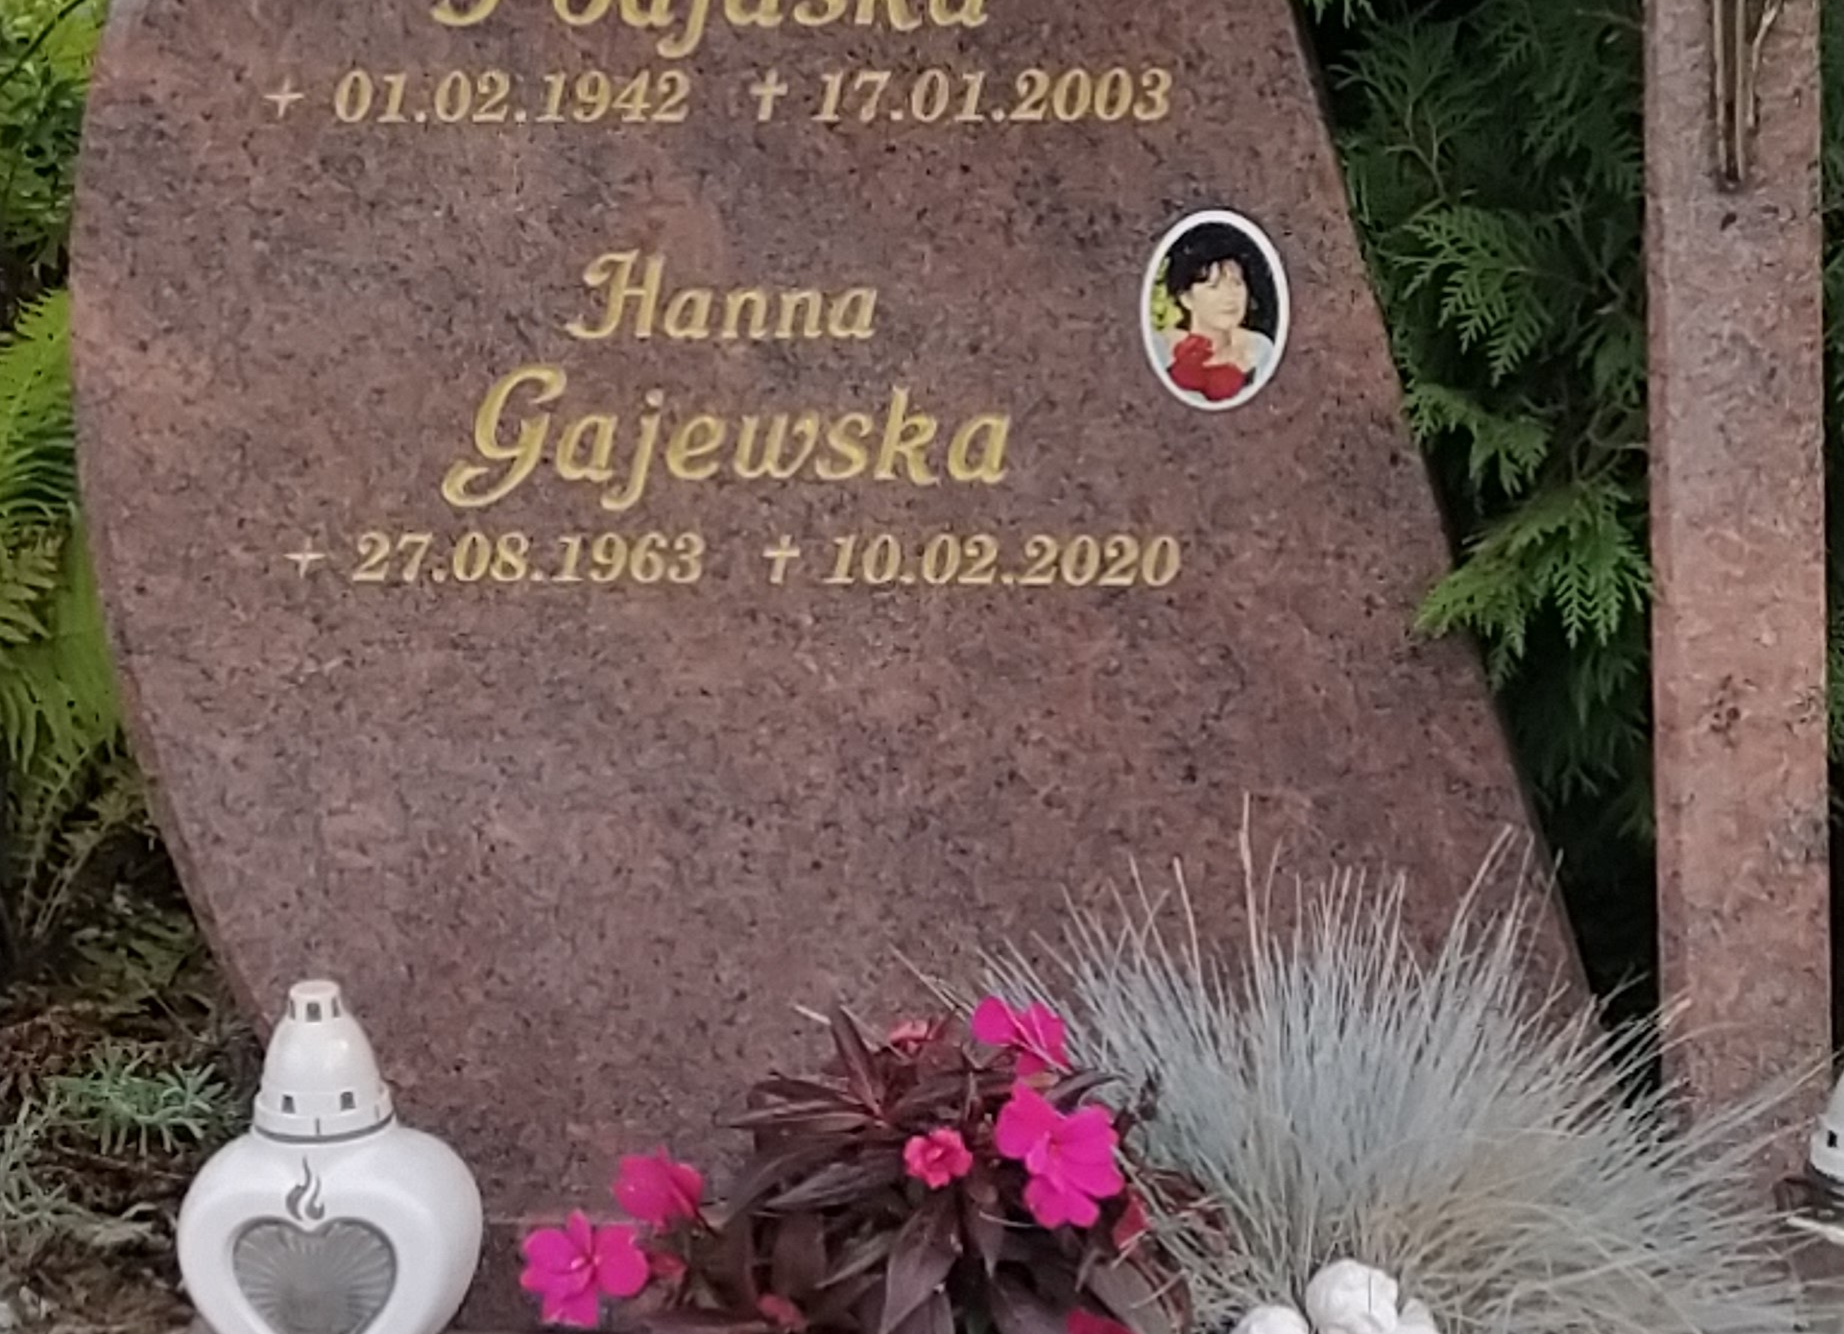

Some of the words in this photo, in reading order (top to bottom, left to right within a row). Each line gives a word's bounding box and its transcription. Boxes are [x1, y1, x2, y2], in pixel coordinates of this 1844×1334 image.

[333, 67, 692, 125] 01.02.1942
[810, 66, 1173, 124] 17.01.2003
[566, 248, 878, 343] Hanna
[440, 362, 1012, 515] Gajewska
[351, 529, 706, 586] 27.08.1963
[829, 532, 1182, 589] 10.02.2020
